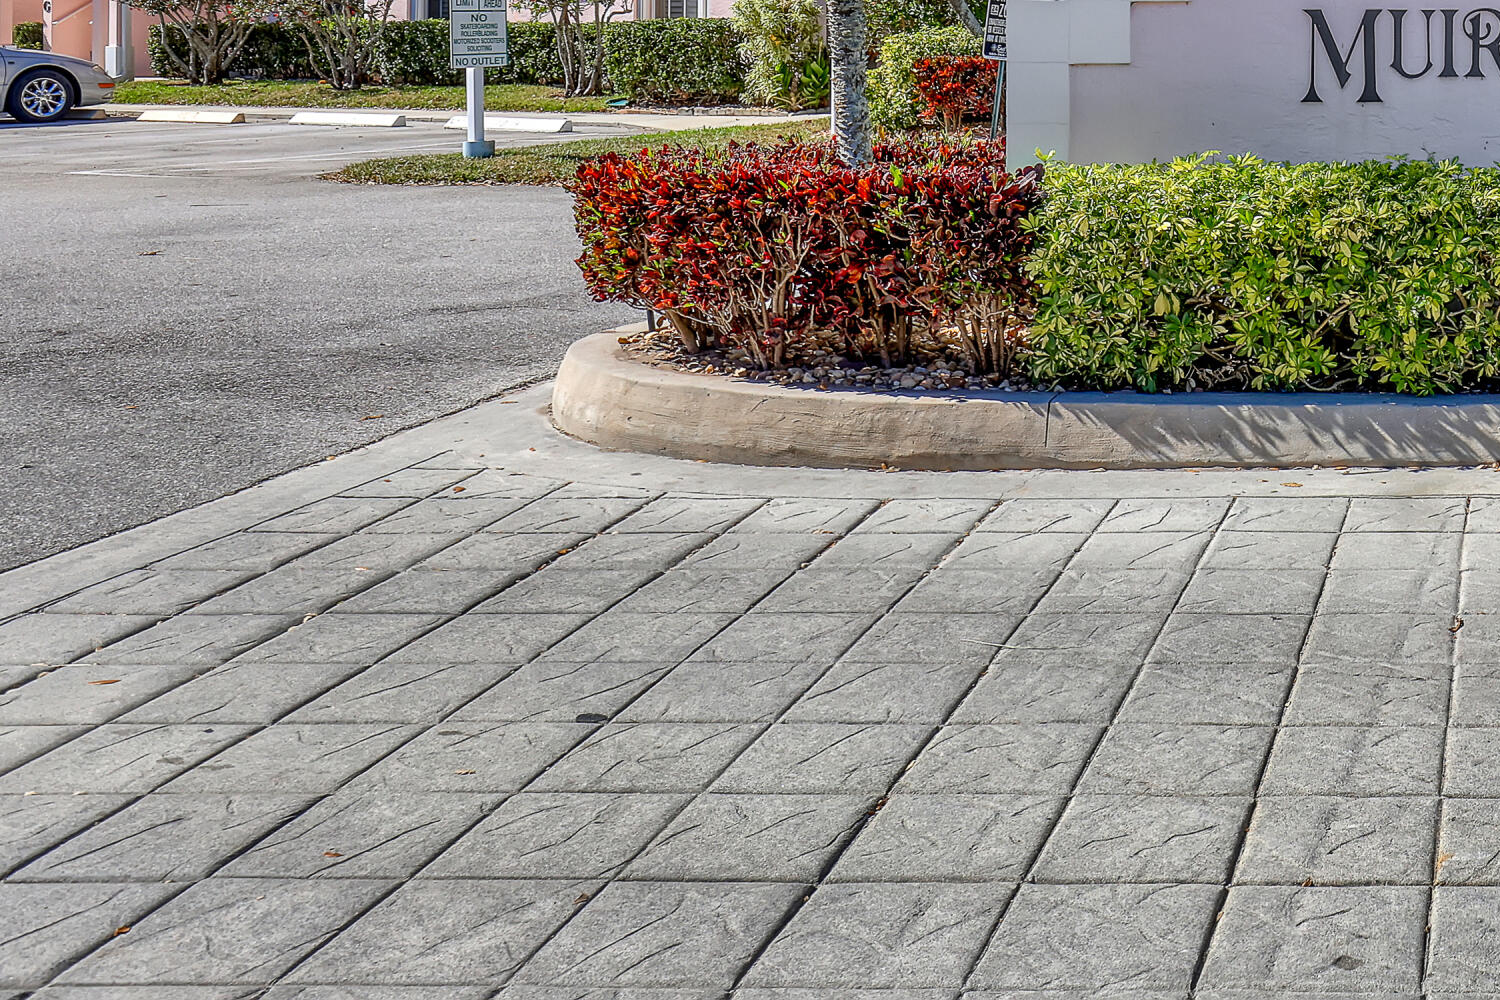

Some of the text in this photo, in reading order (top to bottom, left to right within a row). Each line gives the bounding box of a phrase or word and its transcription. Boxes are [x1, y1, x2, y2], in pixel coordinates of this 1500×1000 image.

[484, 0, 502, 8] AHEAD
[470, 13, 488, 22] NO
[455, 56, 505, 66] NO OUTLET
